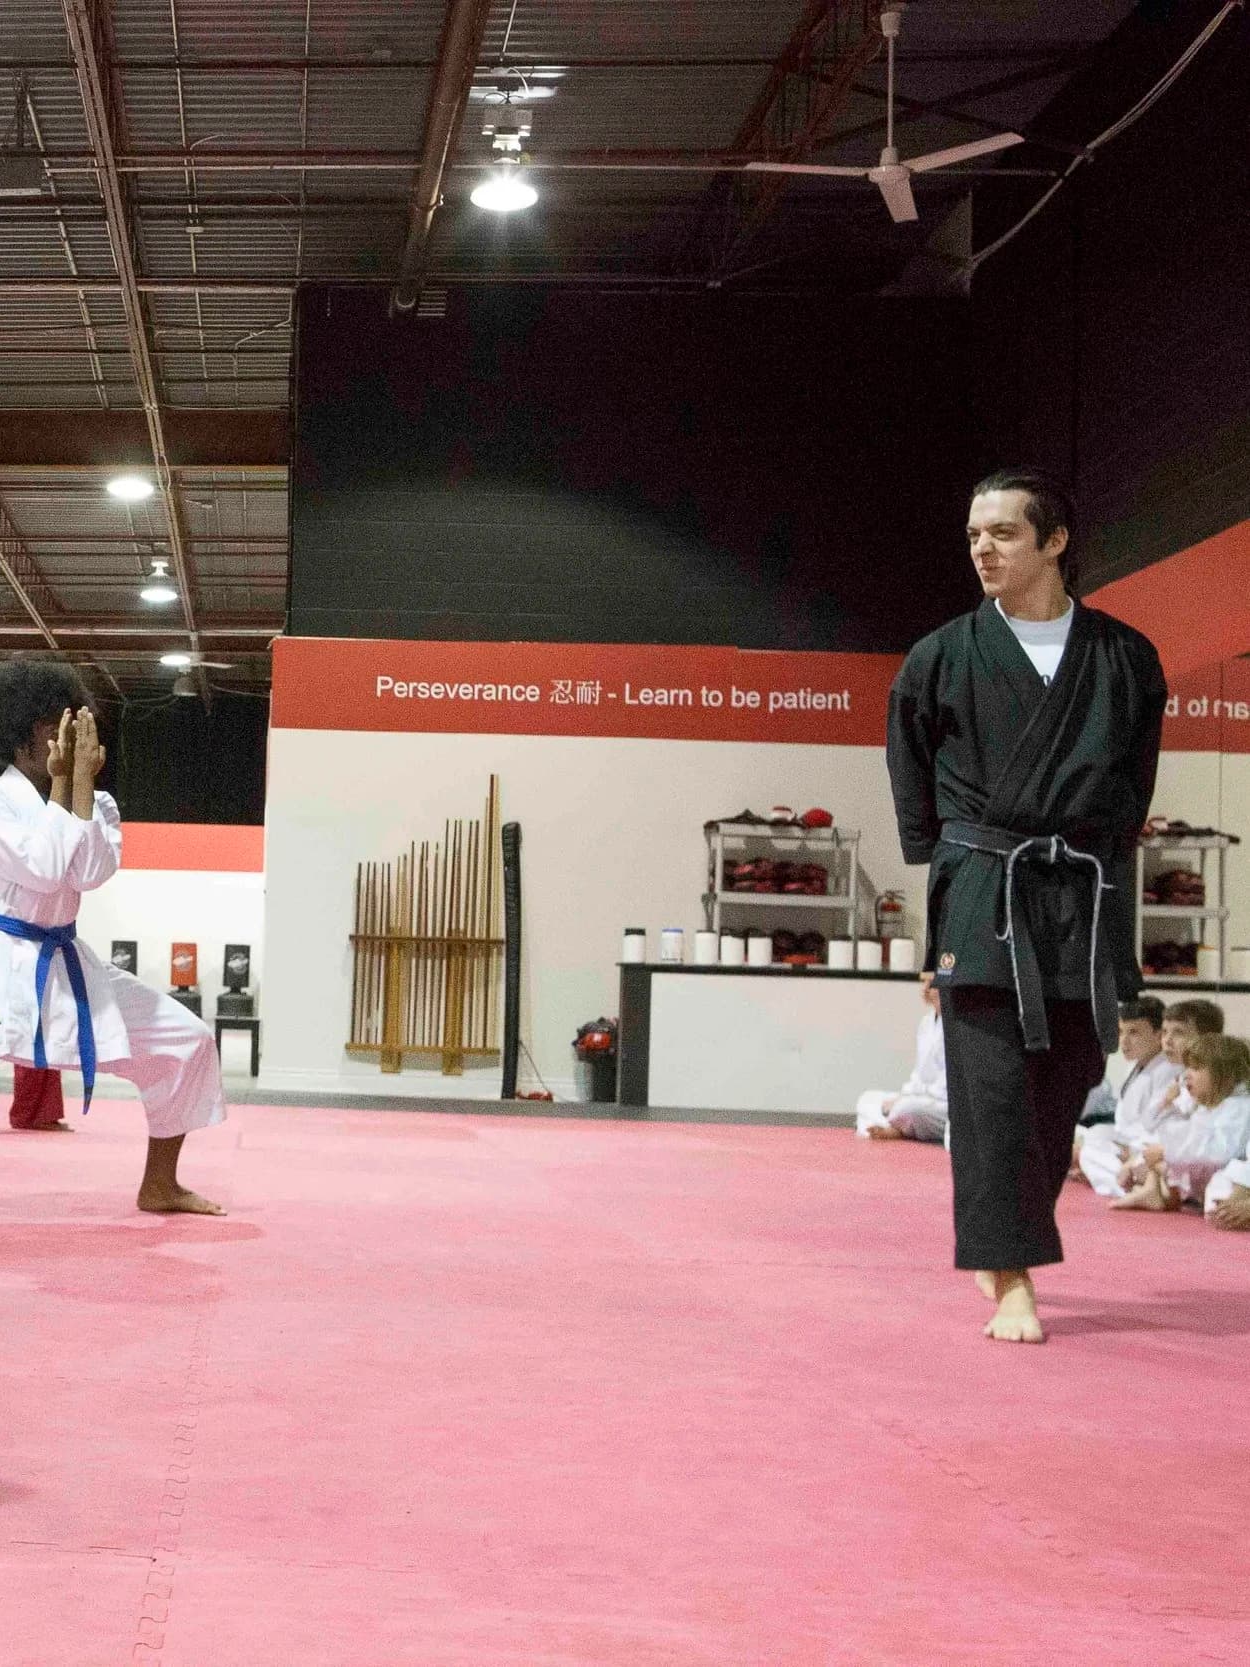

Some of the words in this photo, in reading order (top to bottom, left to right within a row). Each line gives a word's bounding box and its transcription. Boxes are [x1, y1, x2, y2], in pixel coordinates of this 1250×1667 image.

[376, 675, 541, 702] Perseverance
[550, 679, 602, 705] 忍耐
[625, 682, 693, 706] Learn
[701, 686, 723, 707] to
[731, 685, 761, 708] be
[768, 687, 850, 713] patient
